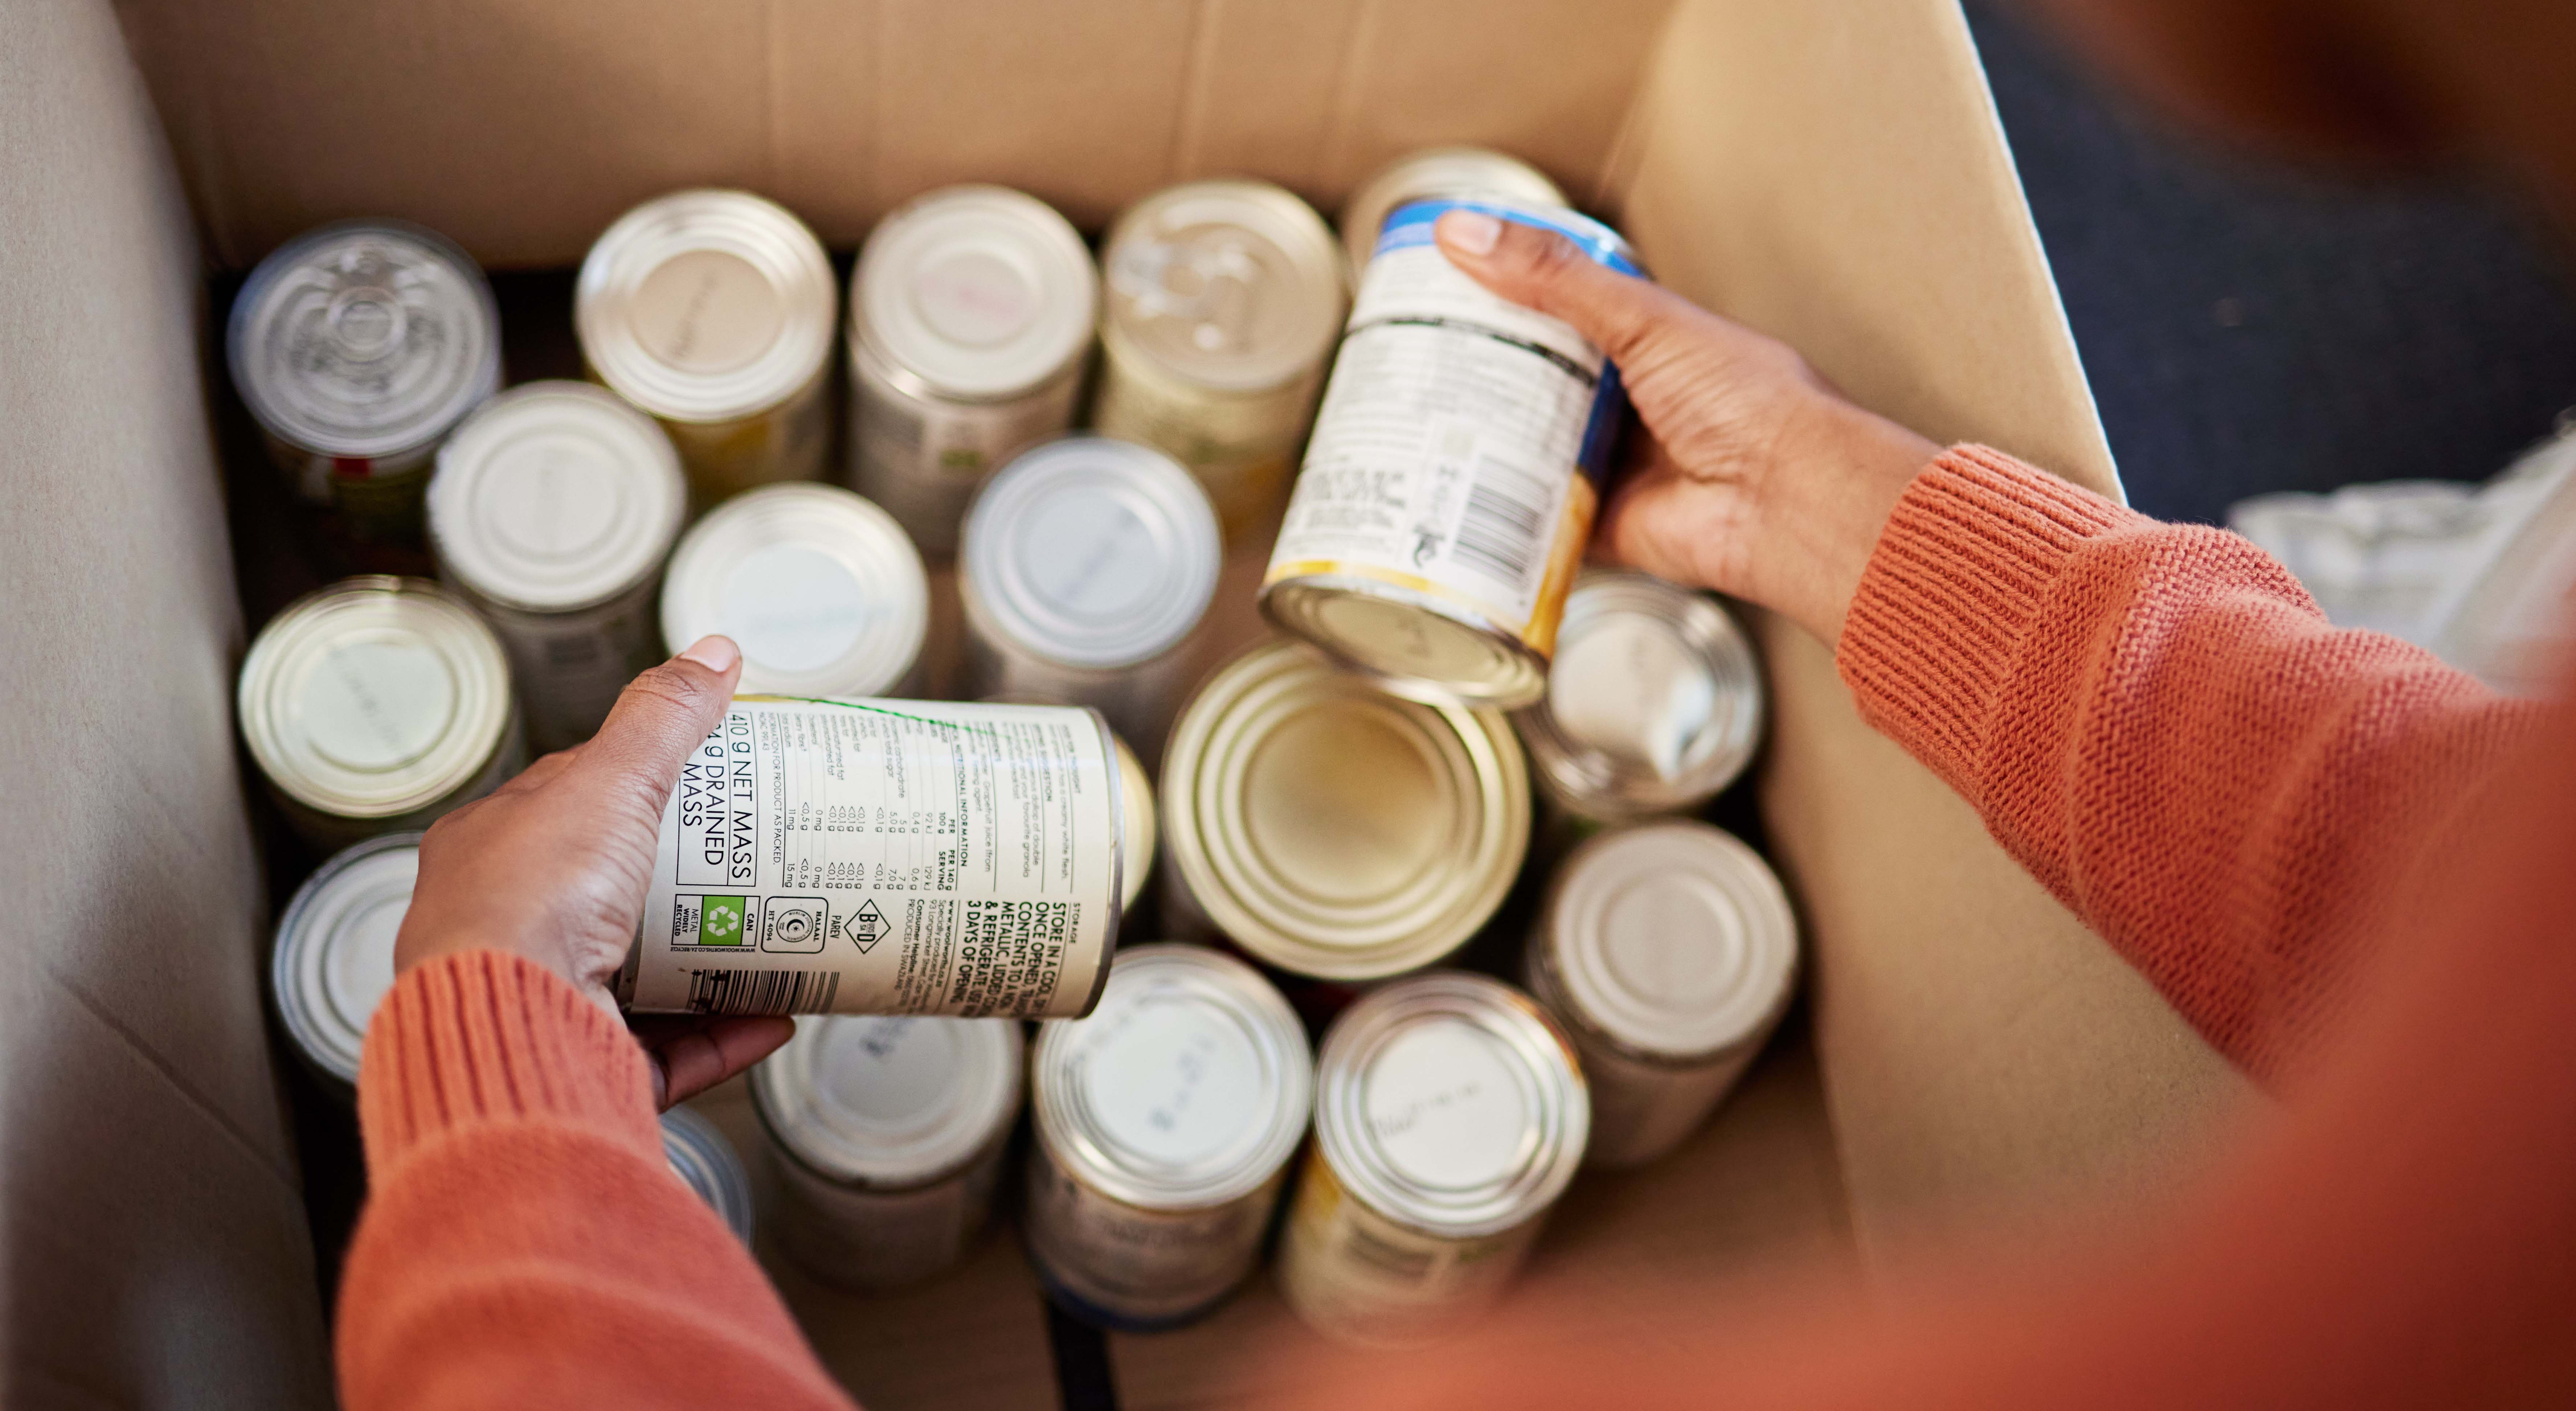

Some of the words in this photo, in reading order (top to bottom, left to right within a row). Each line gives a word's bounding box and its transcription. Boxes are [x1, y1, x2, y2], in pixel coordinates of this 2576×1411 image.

[729, 714, 749, 735] 410
[705, 746, 724, 758] g
[732, 742, 750, 753] g
[733, 761, 752, 801] NET
[894, 747, 905, 798] carbohydrate
[682, 763, 703, 826] MASS
[773, 772, 782, 812] PRODUCT
[705, 766, 725, 865] DRAINED
[774, 814, 781, 825] AS
[800, 802, 809, 822] <0,5
[828, 805, 837, 823] <0,1
[838, 806, 846, 823] <0,1
[847, 806, 856, 823] <0,1
[856, 807, 865, 824] <0,1
[875, 807, 884, 824] <0,1
[888, 812, 897, 824] 5,0
[912, 812, 920, 825] 0,4
[925, 813, 932, 823] 92
[787, 817, 794, 830] mg
[814, 817, 822, 831] mg
[925, 826, 932, 834] kJ
[1034, 824, 1040, 832] of
[960, 799, 968, 867] INFORMATION
[731, 811, 753, 879] MASS
[773, 828, 782, 865] PACKED.
[787, 863, 795, 871] 15
[800, 858, 809, 879] <0,5
[827, 862, 835, 880] <0,1
[836, 862, 845, 880] <0,1
[846, 862, 855, 880] <0,1
[855, 863, 864, 881] <0,1
[874, 863, 883, 881] <0,1
[888, 869, 896, 881] 7,0
[911, 868, 920, 882] 0,6
[785, 874, 793, 888] mg
[812, 875, 820, 888] mg
[924, 882, 931, 891] kJ
[928, 899, 937, 909] 93
[985, 901, 998, 910] &
[674, 904, 683, 936] RECYCLED
[681, 908, 690, 933] WIDELY
[690, 909, 699, 933] METAL
[746, 913, 755, 931] CAN
[768, 910, 774, 921] HT
[903, 899, 915, 943] PRODUCED
[913, 899, 925, 941] Consumer
[935, 900, 946, 936] Specially
[1033, 902, 1049, 938] ONCE
[1048, 903, 1066, 942] STORE
[1070, 903, 1080, 943] STORAGE
[813, 911, 822, 942] HALAAL
[830, 915, 841, 939] PAREV
[925, 911, 936, 956] Longmarket
[964, 912, 980, 943] DAYS
[993, 902, 1015, 961] METALLIC,
[1011, 902, 1032, 966] CONTENTS
[930, 938, 941, 972] produced
[962, 947, 976, 962] OF
[1047, 946, 1061, 957] IN
[1022, 943, 1044, 987] OPENED,
[986, 964, 1007, 995] LIDDED
[1007, 969, 1023, 983] TO
[1037, 971, 1056, 996] COOL
